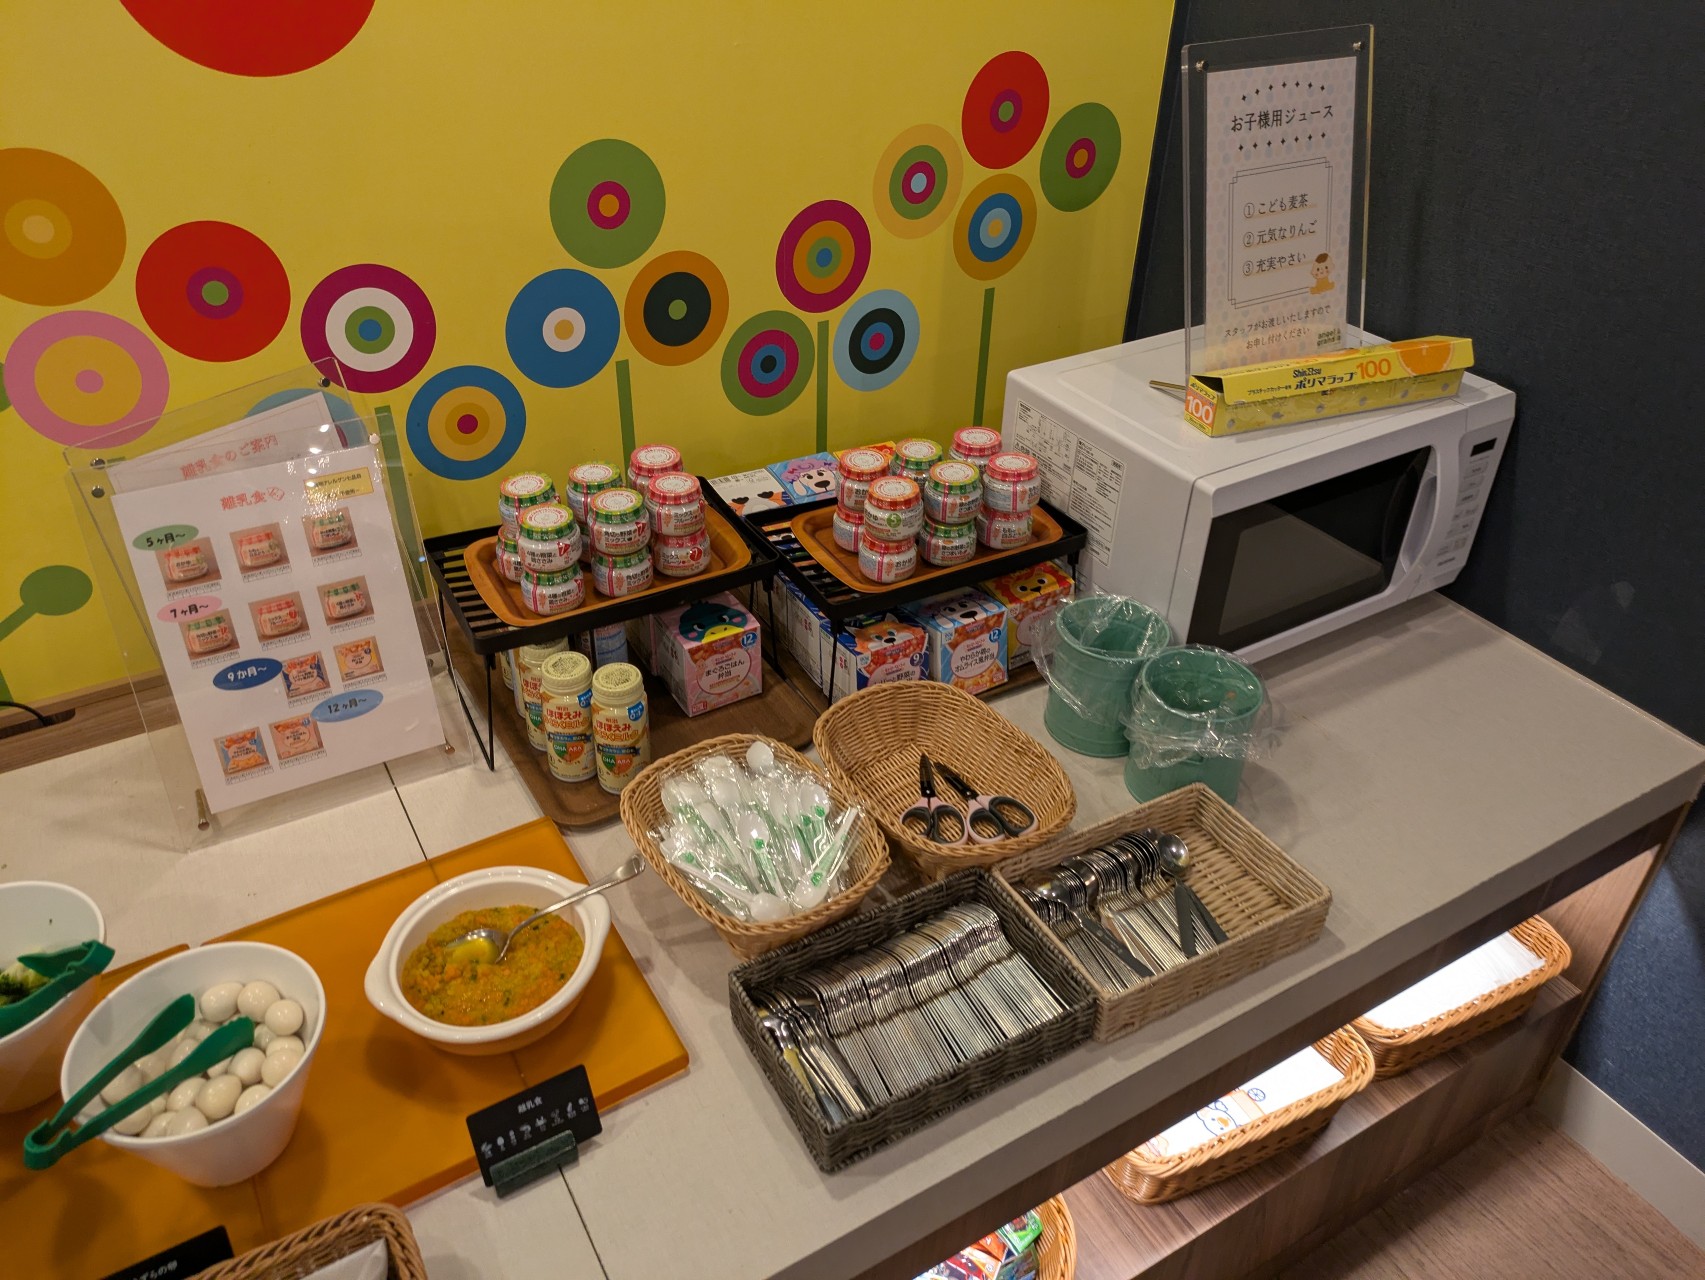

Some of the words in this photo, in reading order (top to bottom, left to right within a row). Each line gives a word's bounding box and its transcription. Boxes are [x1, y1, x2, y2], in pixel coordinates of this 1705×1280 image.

[1230, 105, 1334, 133] お子様用ジュース
[1224, 304, 1331, 338] スタッフがお渡しいたしますので
[1246, 326, 1310, 349] お申し付けください
[1294, 371, 1356, 391] ポリマラップ
[1356, 357, 1392, 380] 100
[1186, 394, 1214, 425] 100
[220, 489, 267, 511] 離乳食
[889, 514, 898, 527] 5
[743, 633, 754, 645] 12
[990, 629, 1000, 642] 12
[705, 659, 745, 677] まぐろごはん
[522, 679, 541, 690] ほほ
[546, 709, 583, 721] ほほえみ
[596, 721, 631, 732] ほほえみ
